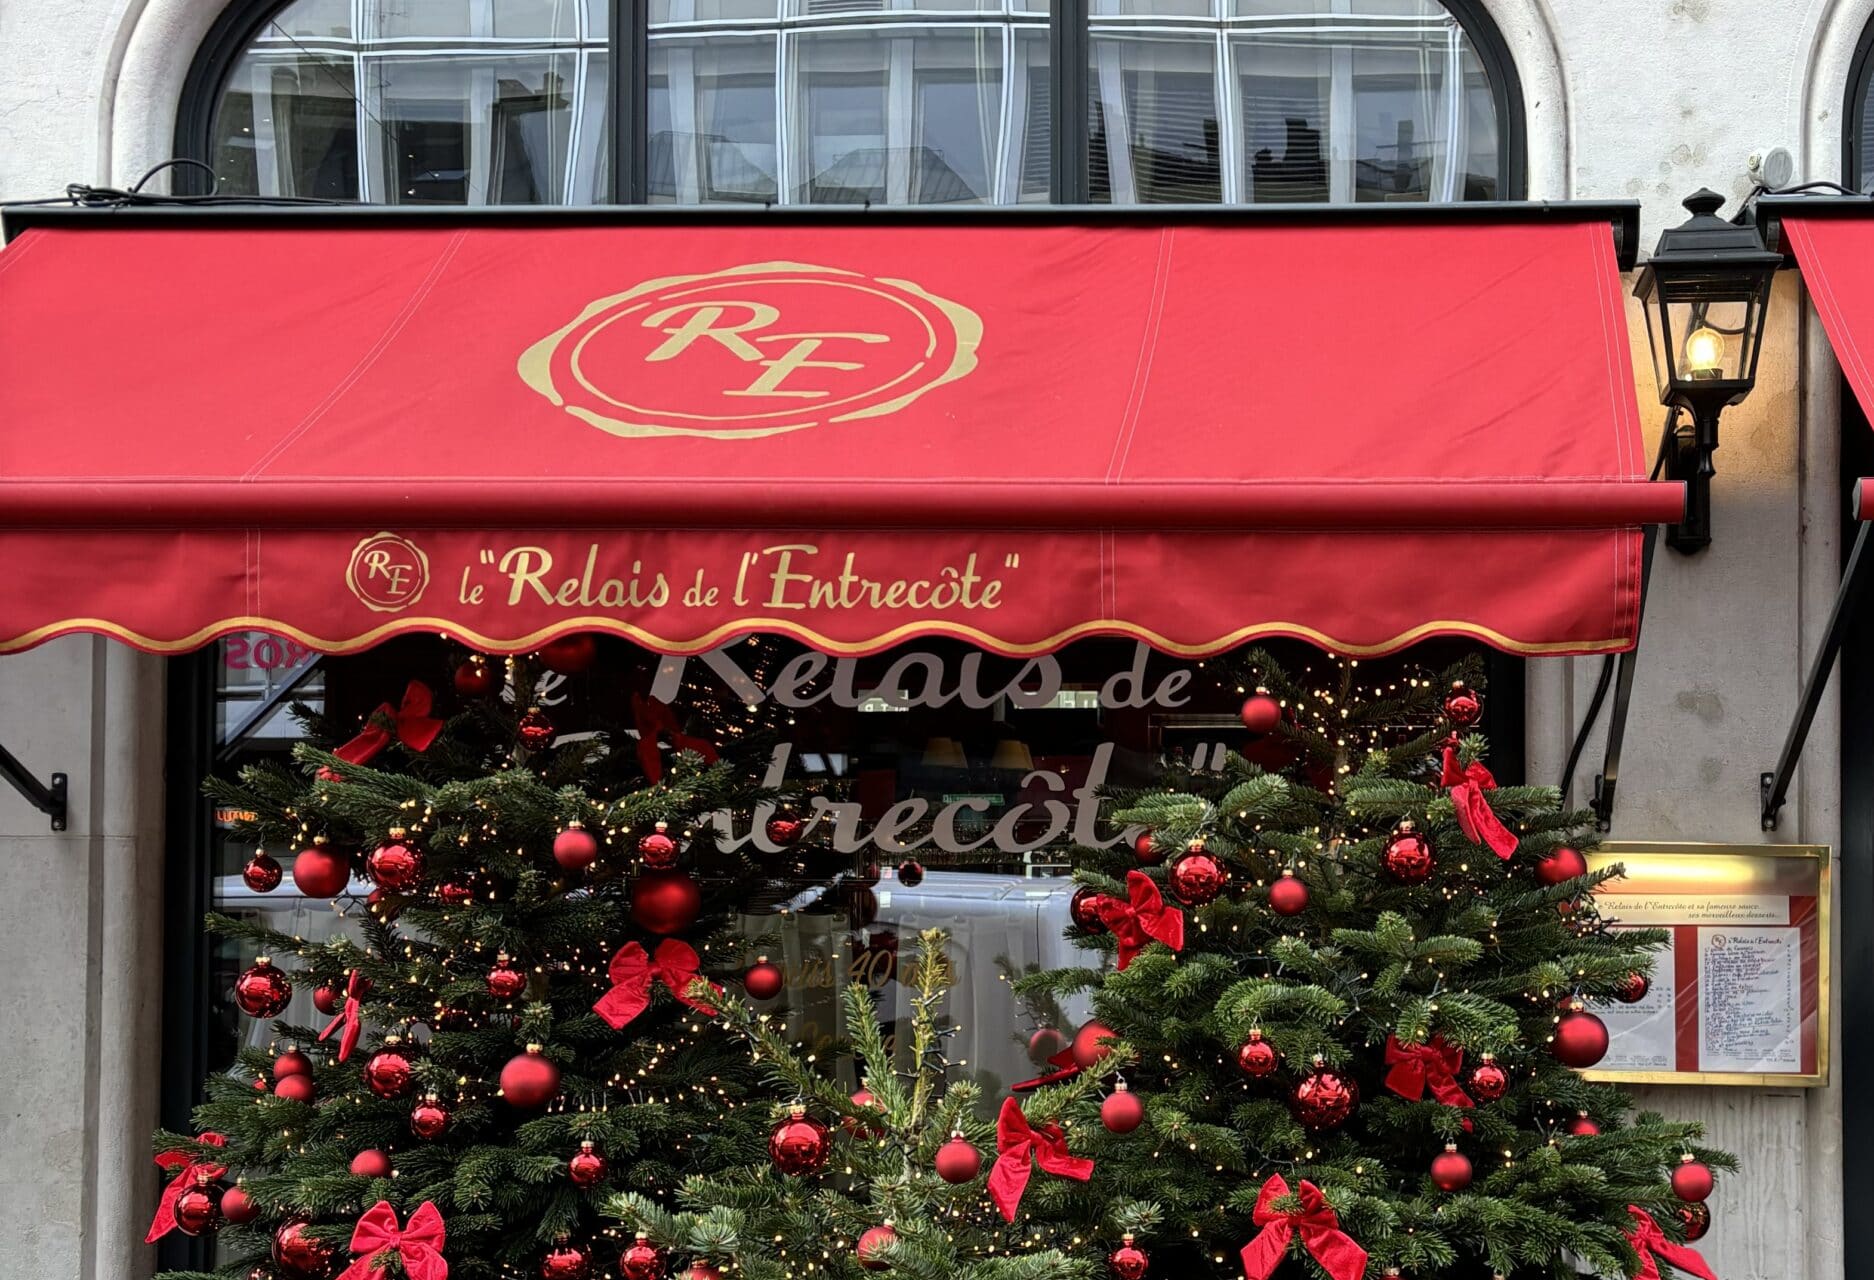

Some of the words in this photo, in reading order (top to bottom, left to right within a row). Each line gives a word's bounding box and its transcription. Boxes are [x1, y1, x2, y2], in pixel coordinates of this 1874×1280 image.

[459, 566, 484, 605] le
[683, 568, 719, 607] de
[1100, 642, 1193, 708] de
[848, 948, 894, 988] 40
